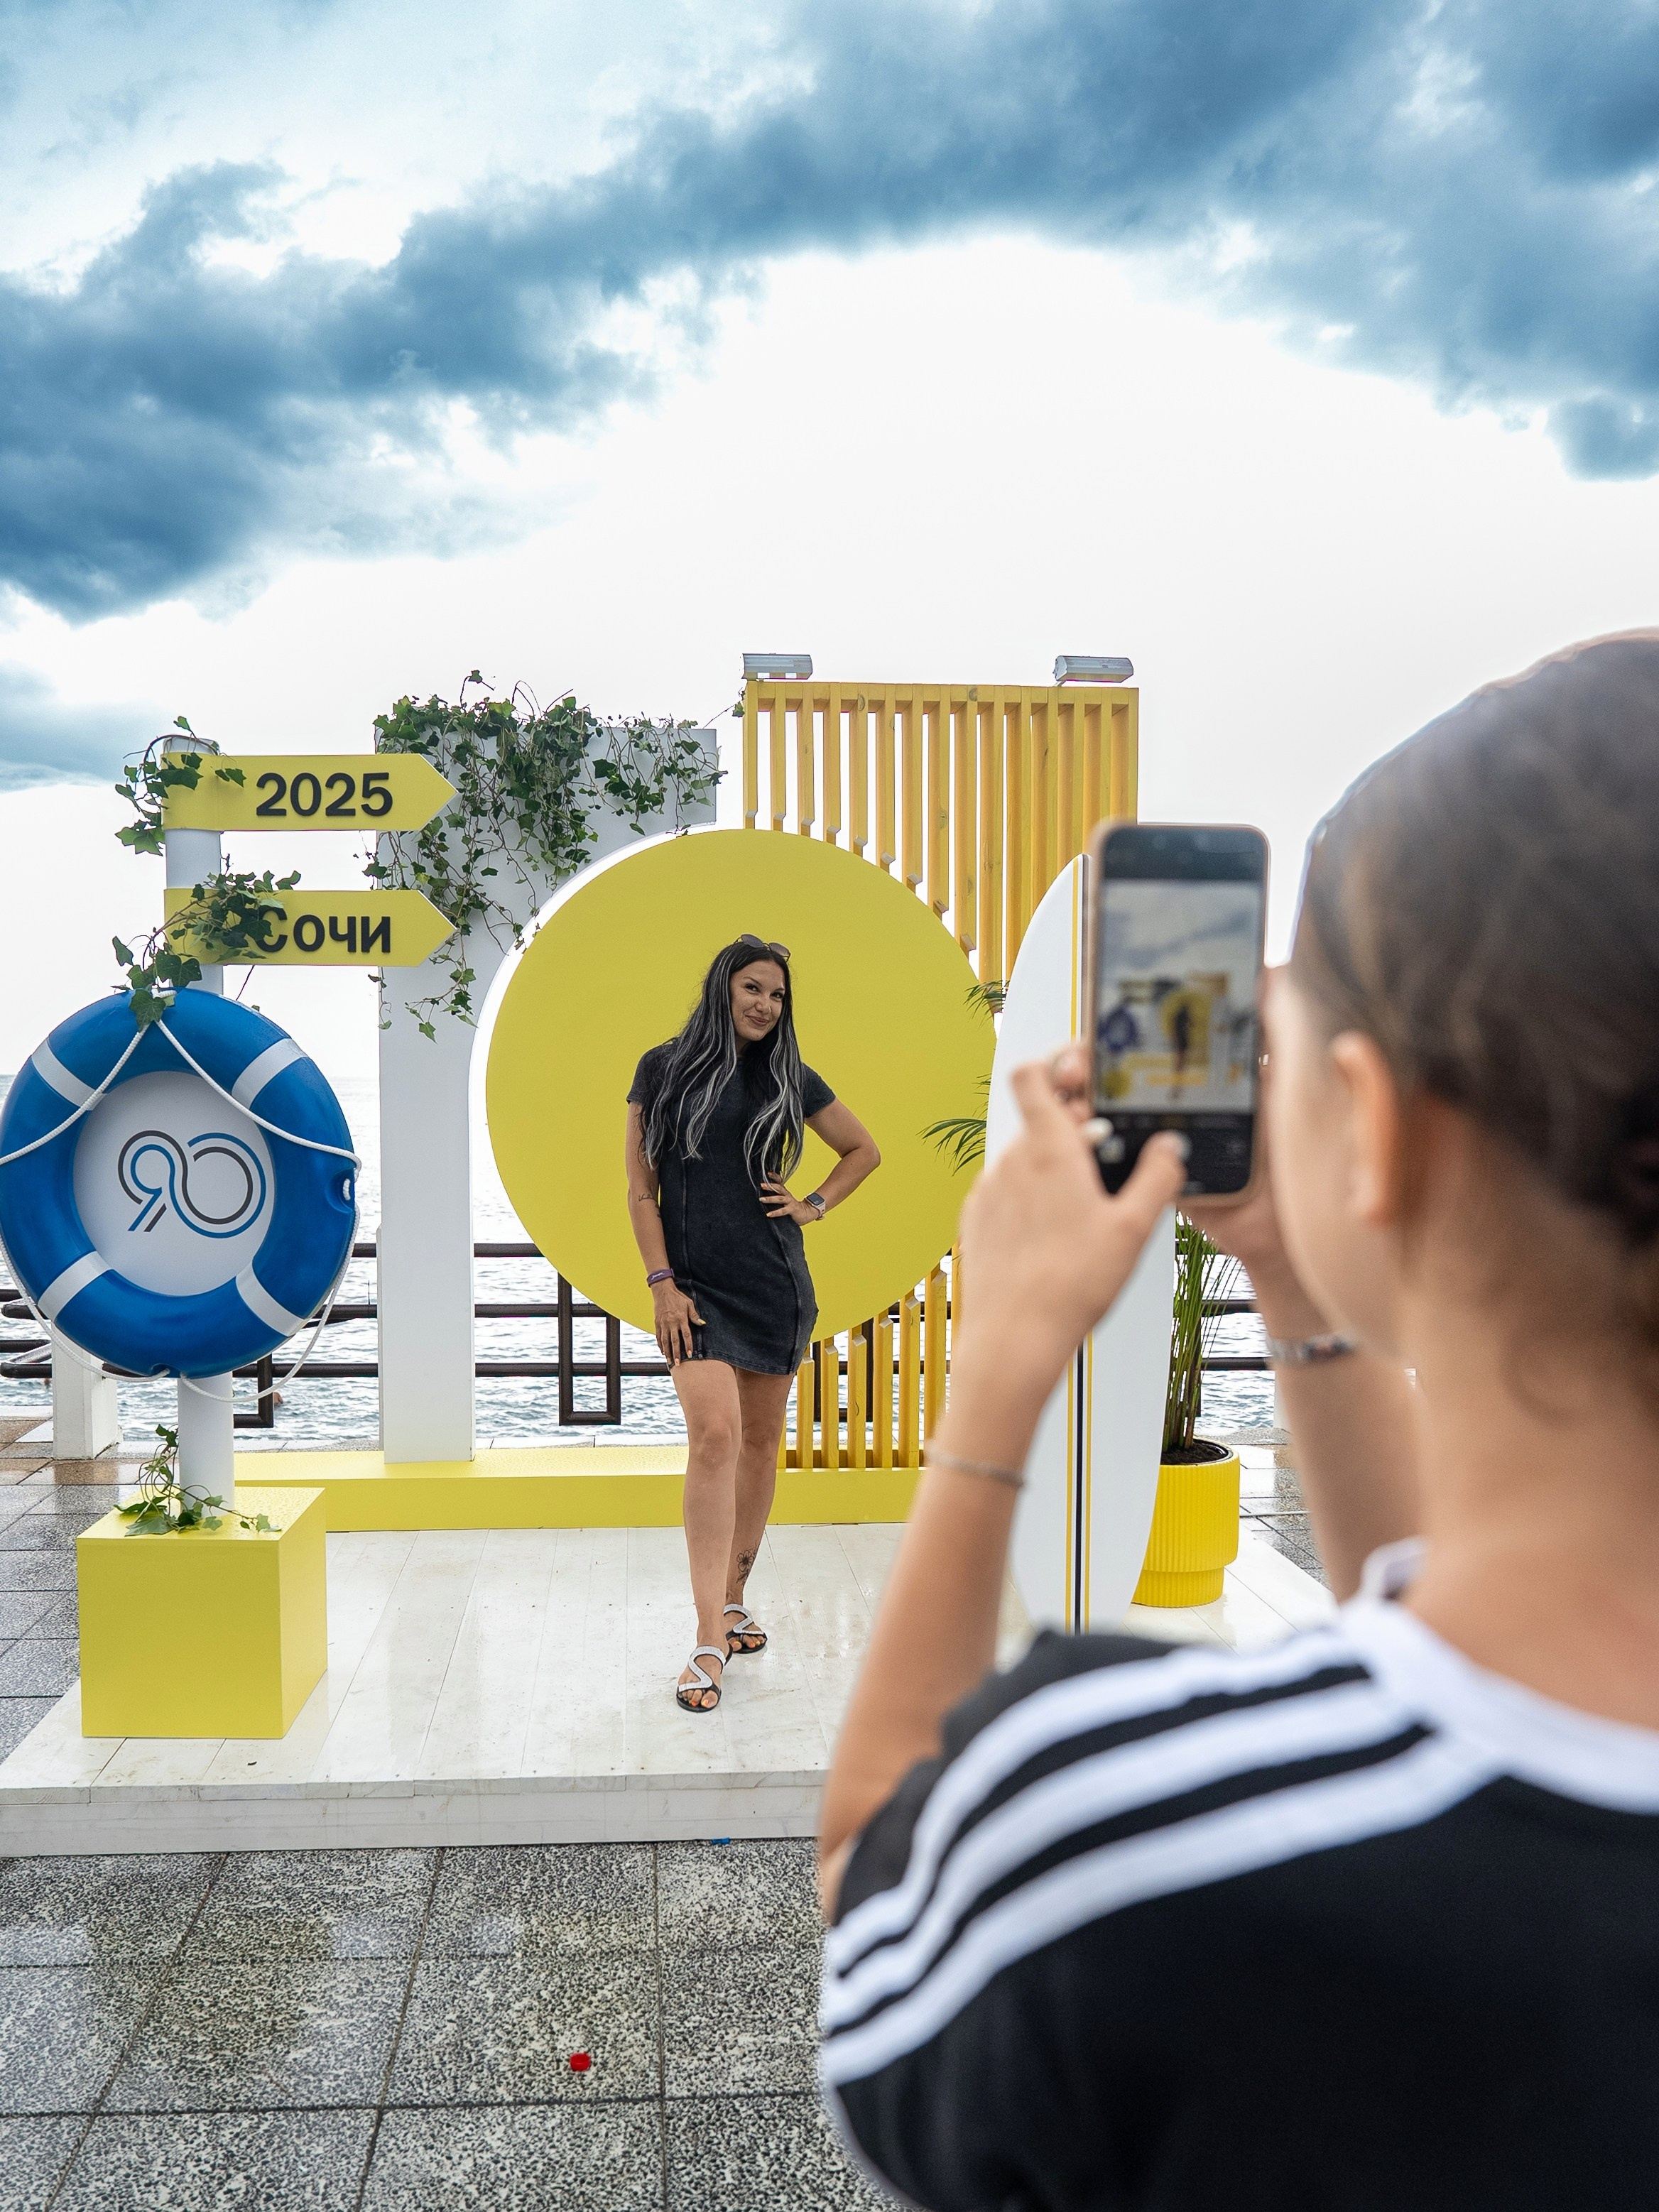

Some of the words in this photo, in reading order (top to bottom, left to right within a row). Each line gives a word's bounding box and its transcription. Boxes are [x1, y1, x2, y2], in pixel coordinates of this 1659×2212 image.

[256, 772, 393, 817] 2025
[256, 907, 391, 953] Сочи
[117, 1130, 267, 1239] 90
